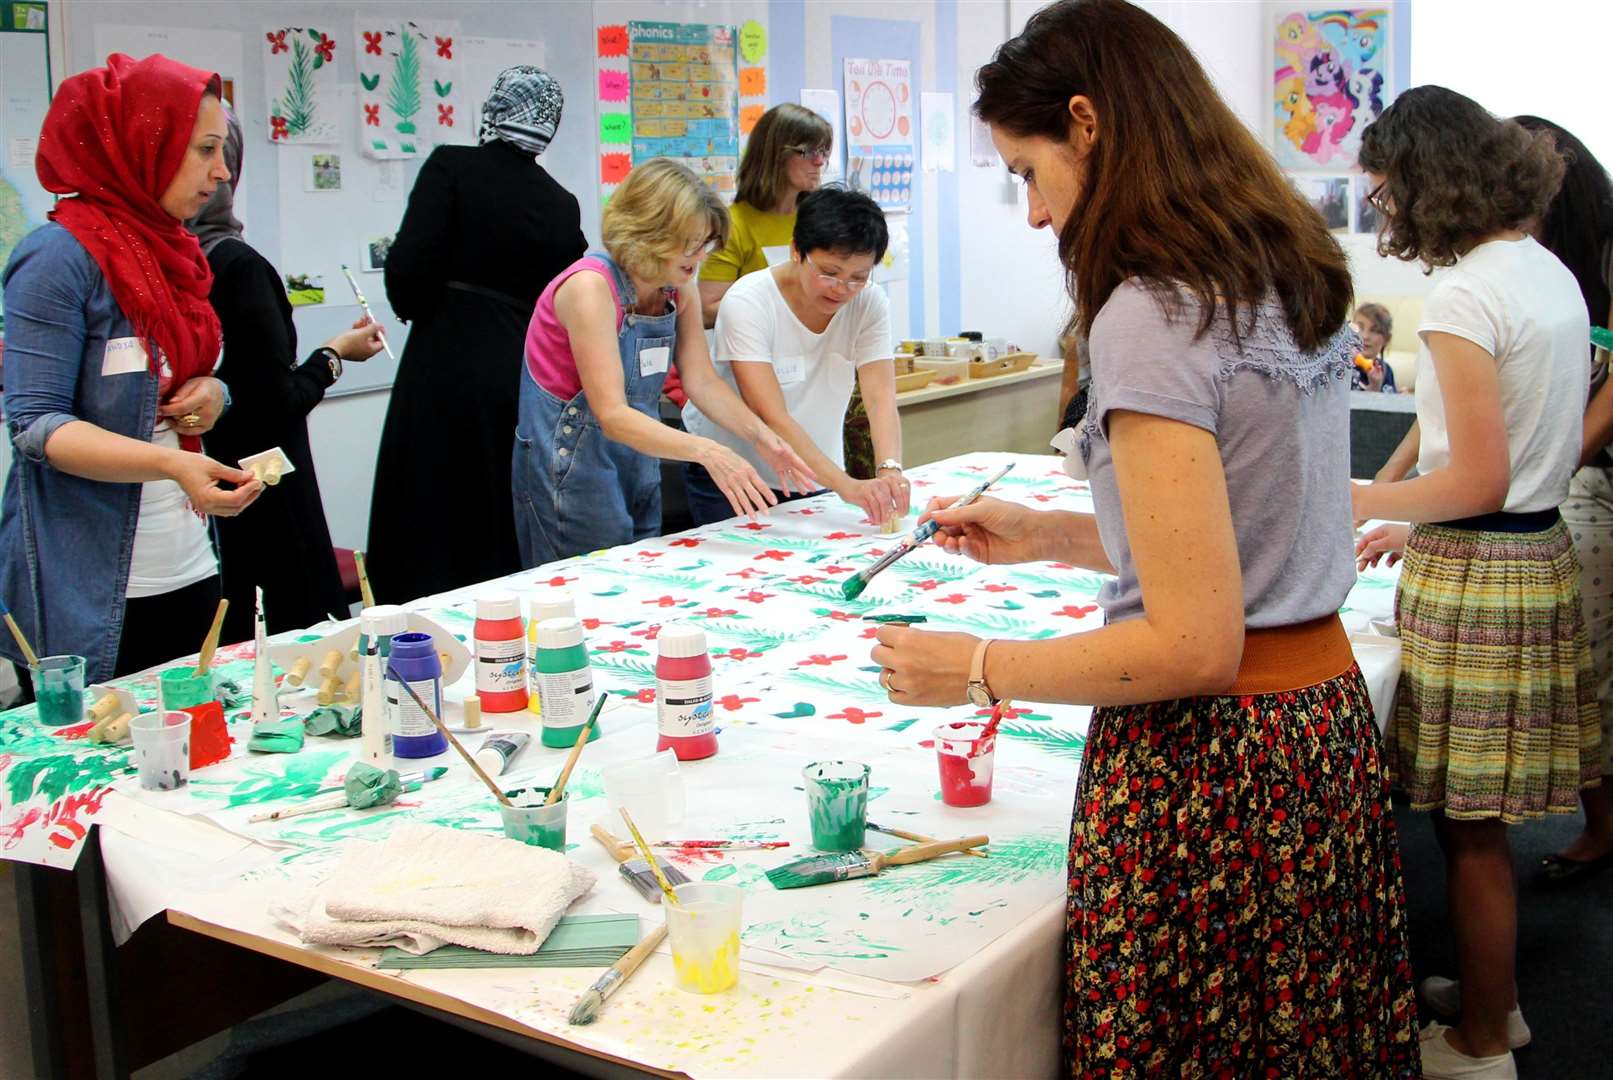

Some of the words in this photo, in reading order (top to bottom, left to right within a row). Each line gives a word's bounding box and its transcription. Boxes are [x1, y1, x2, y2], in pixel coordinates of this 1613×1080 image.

[631, 24, 673, 40] phonics
[847, 62, 866, 76] Tell
[886, 63, 909, 79] Time
